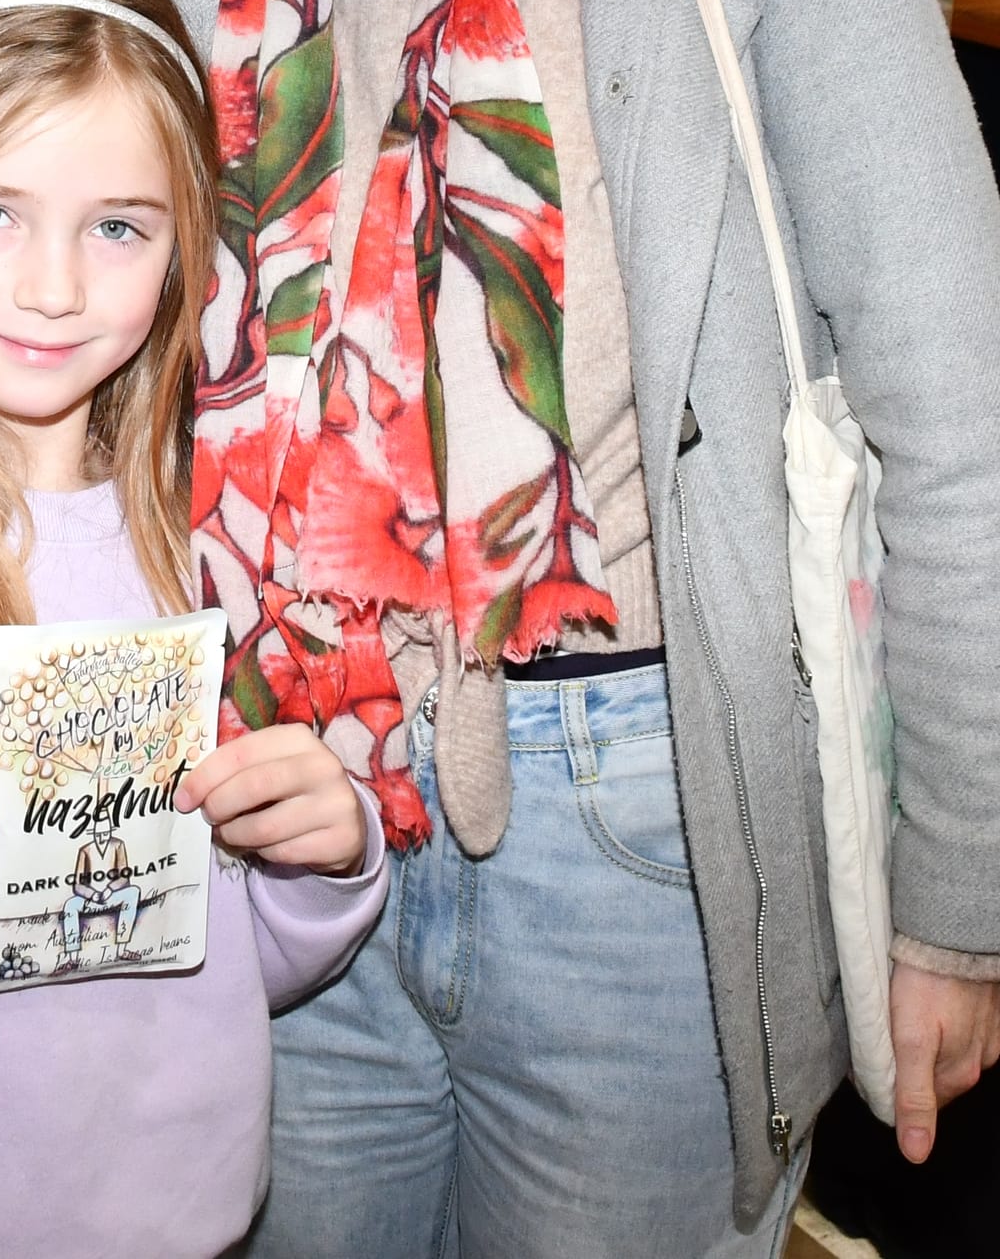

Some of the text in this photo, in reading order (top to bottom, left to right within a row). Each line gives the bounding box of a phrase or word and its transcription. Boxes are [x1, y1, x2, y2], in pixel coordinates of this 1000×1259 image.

[36, 668, 188, 758] CHOCOLATE
[114, 731, 133, 753] by
[24, 759, 192, 839] hazelnut
[7, 853, 177, 895] DARK CHOCOLATE
[46, 930, 109, 950] Australian
